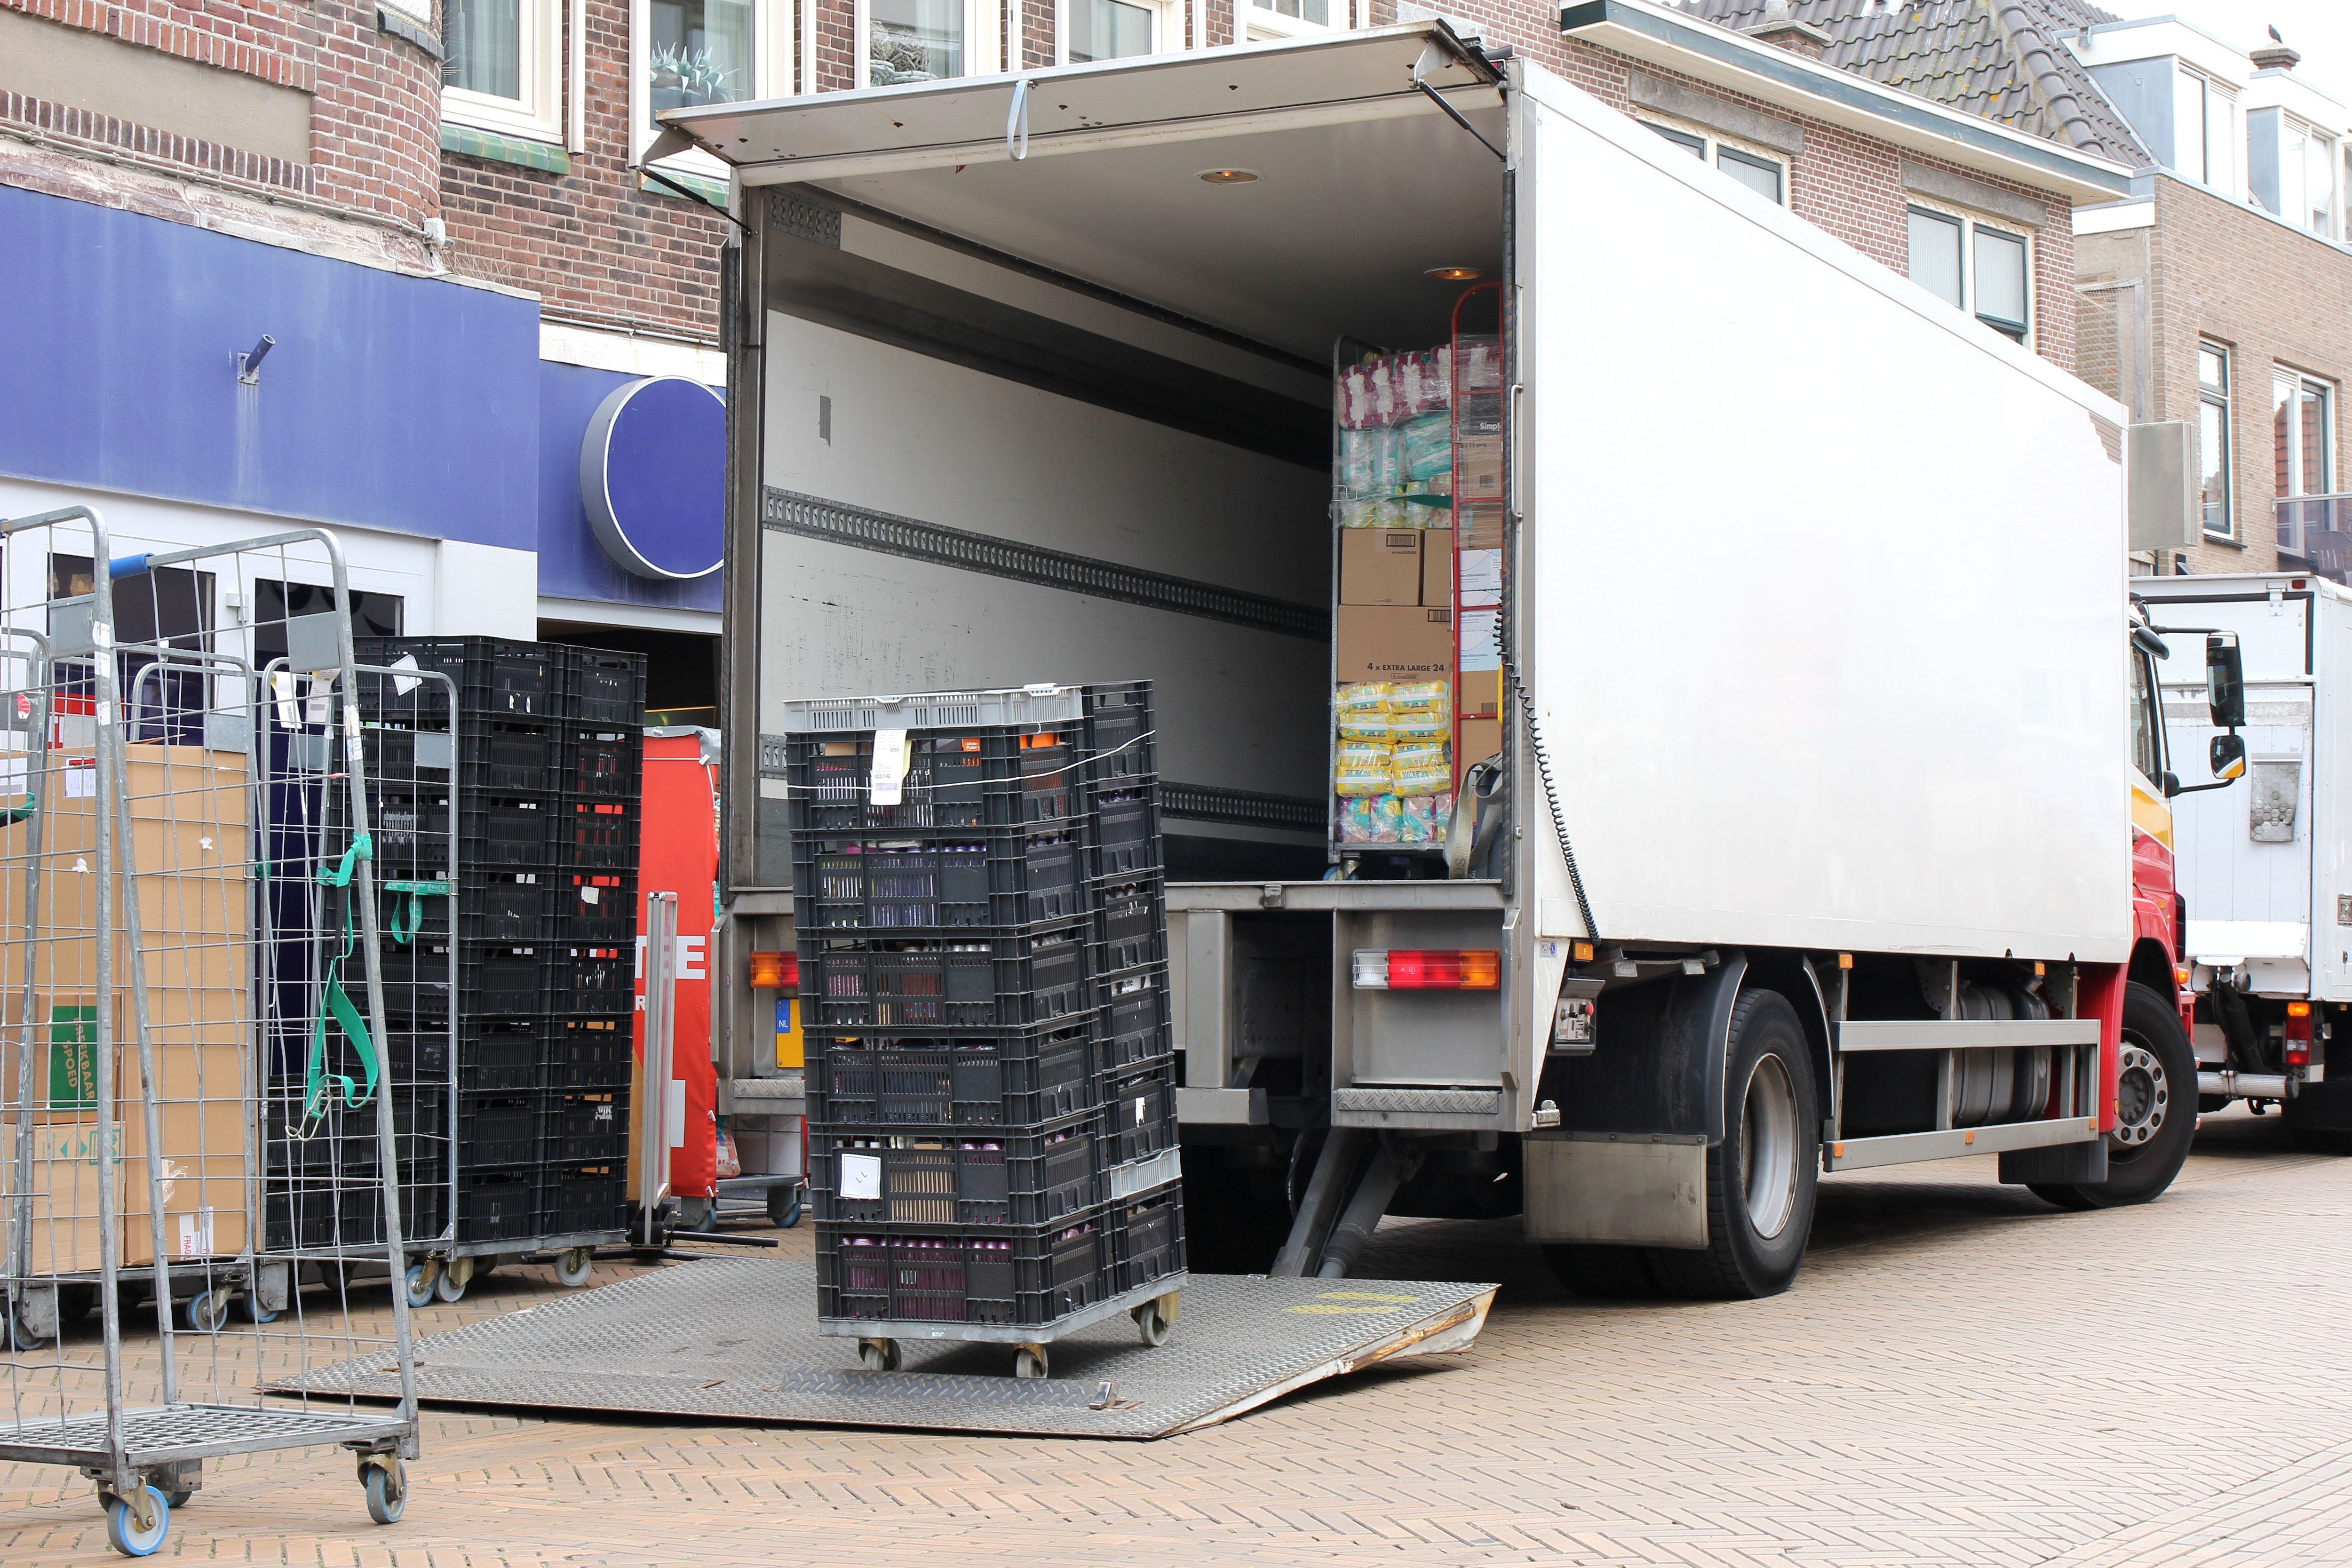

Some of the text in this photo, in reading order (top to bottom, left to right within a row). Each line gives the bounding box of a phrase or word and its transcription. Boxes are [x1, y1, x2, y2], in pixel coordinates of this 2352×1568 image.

[1480, 422, 1500, 431] Simpl
[779, 1019, 789, 1028] NL
[63, 1040, 78, 1088] SPOED
